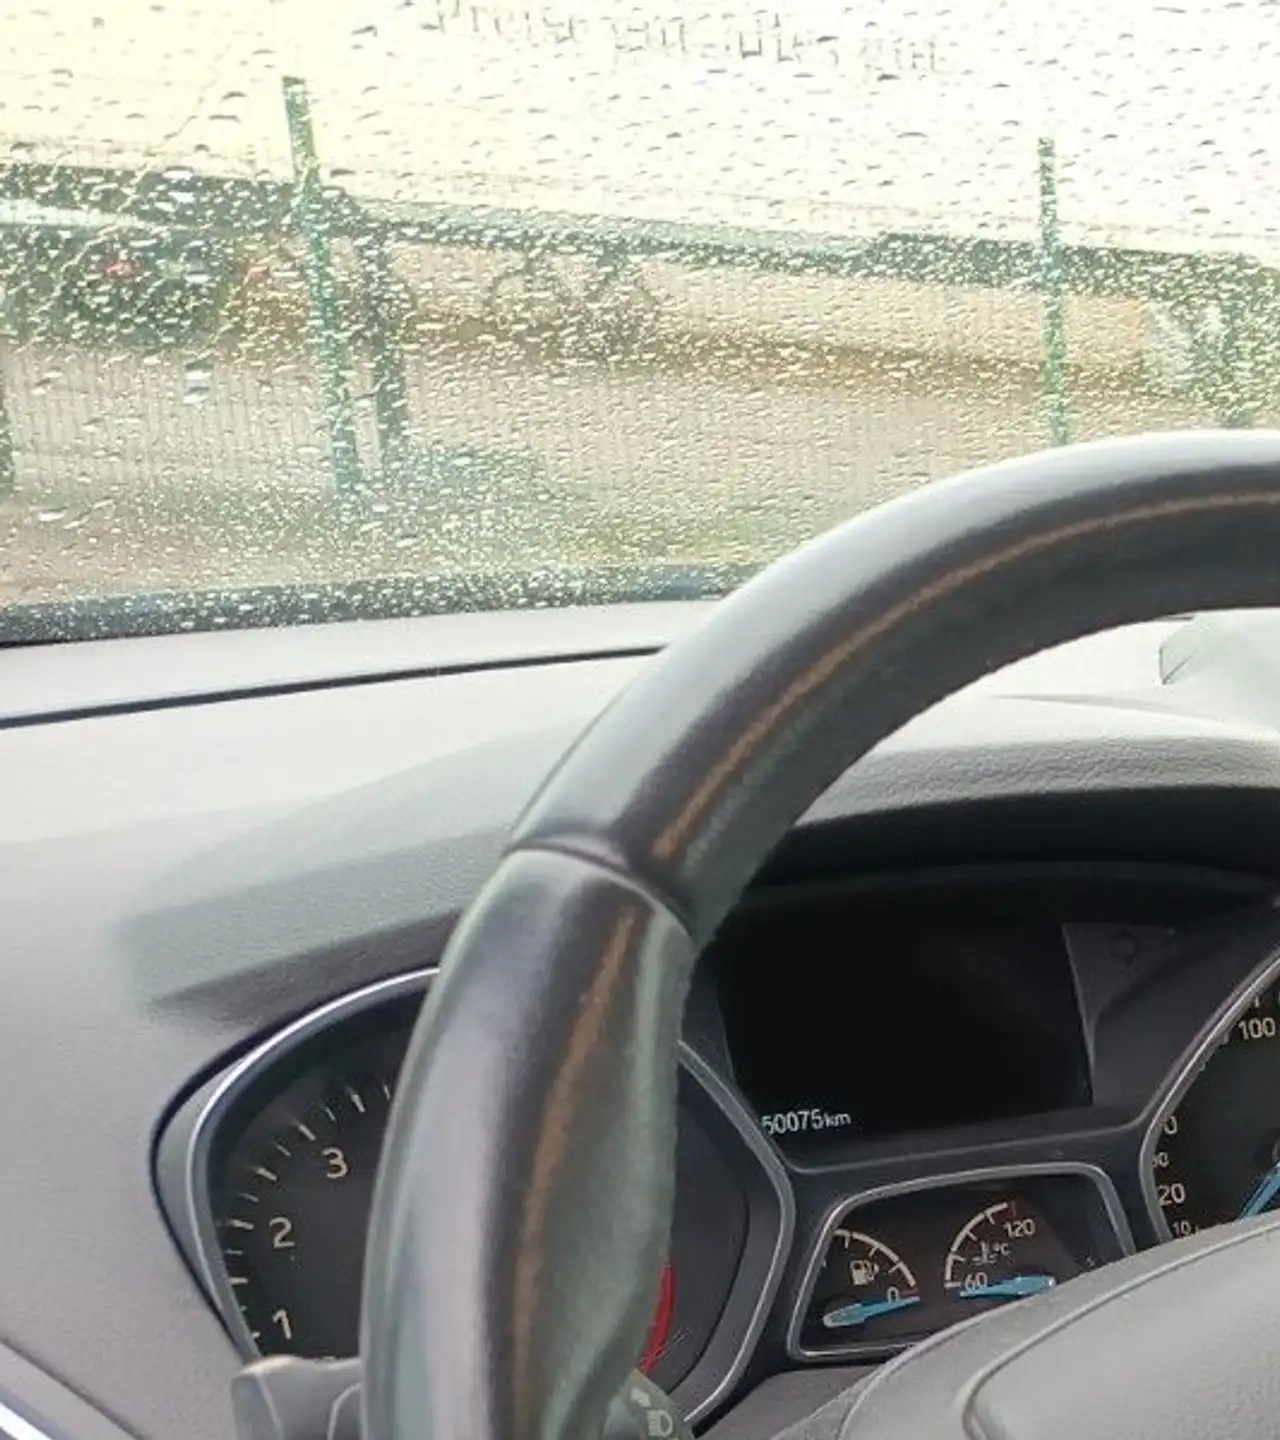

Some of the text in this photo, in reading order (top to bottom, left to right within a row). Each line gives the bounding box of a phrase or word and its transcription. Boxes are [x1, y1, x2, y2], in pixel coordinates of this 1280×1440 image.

[1238, 1017, 1276, 1040] 100
[321, 1147, 349, 1180] 3
[1158, 1182, 1186, 1207] 20
[268, 1216, 296, 1249] 2
[1003, 1218, 1036, 1239] 120
[963, 1271, 989, 1292] 60
[271, 1309, 293, 1341] 1
